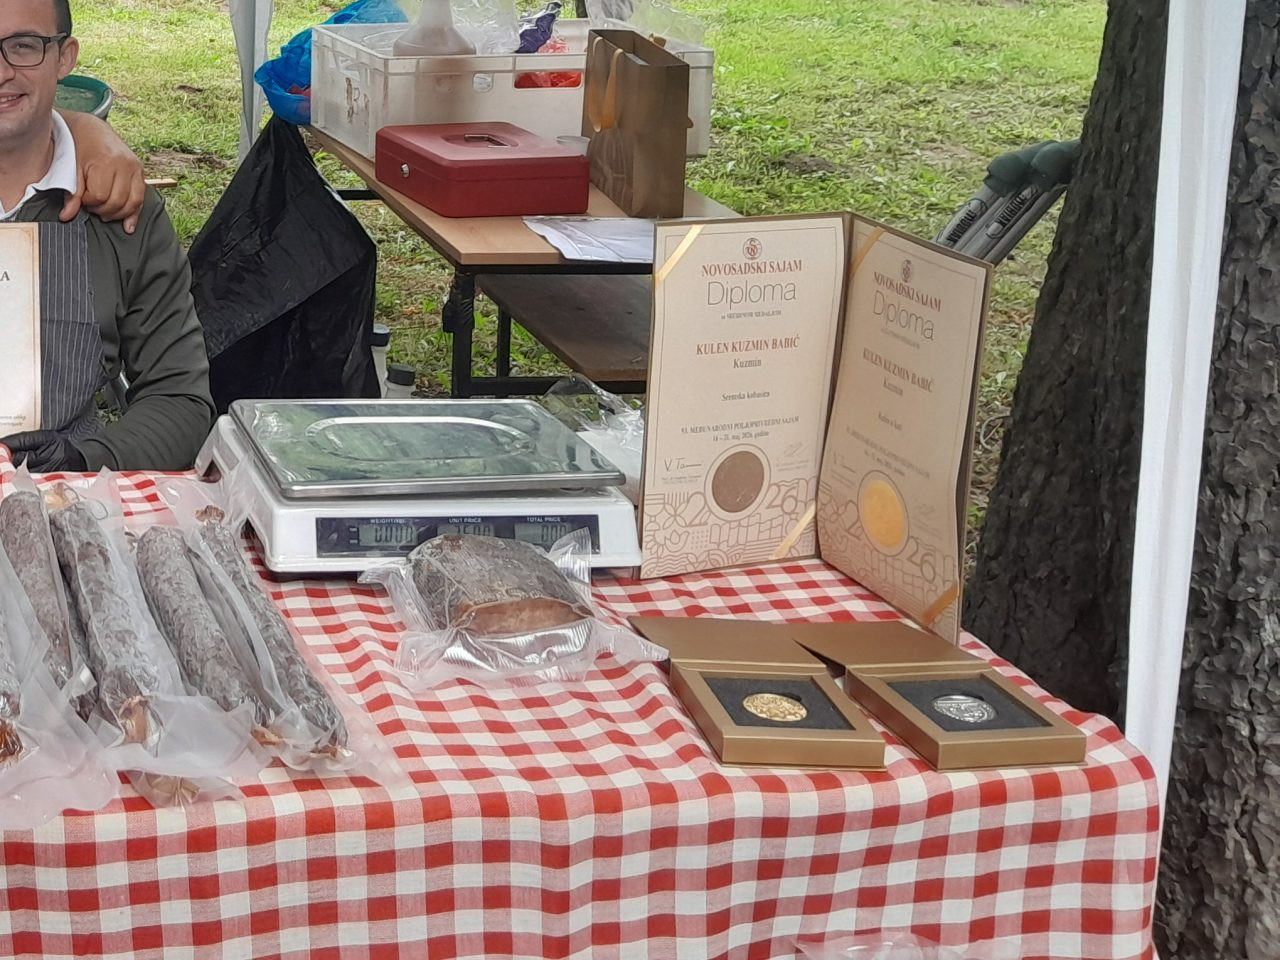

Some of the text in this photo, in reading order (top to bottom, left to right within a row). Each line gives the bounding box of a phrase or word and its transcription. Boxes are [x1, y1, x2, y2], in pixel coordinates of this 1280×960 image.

[702, 259, 802, 277] NOVOSADSKI SAJAM
[707, 280, 797, 310] Diploma
[873, 290, 934, 341] Diploma
[696, 334, 800, 355] KULEN KUZMIN BABIĆ
[733, 358, 762, 369] Kuzmin
